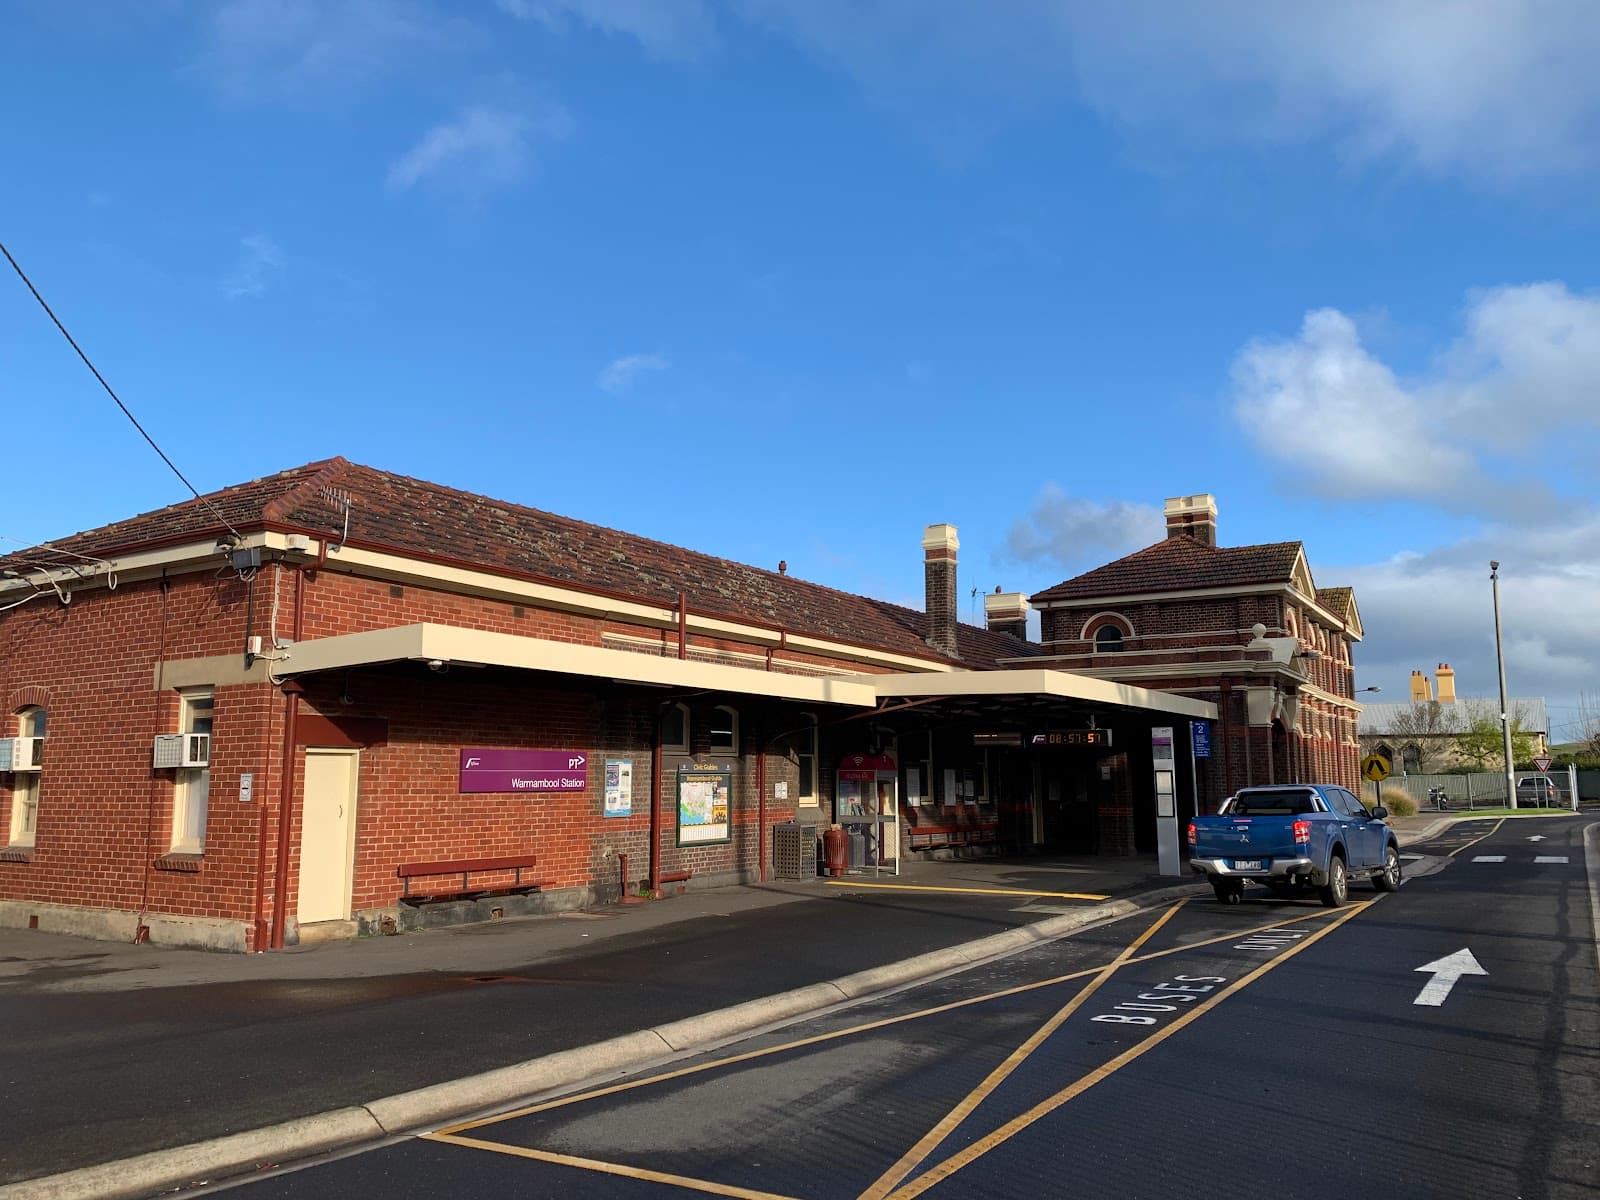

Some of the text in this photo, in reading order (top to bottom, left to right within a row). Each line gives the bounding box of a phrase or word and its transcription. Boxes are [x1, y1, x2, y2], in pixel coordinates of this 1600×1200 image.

[1197, 725, 1204, 734] 2
[561, 778, 585, 788] Station
[1232, 928, 1310, 950] ONLY
[1090, 974, 1227, 1025] BUSES
